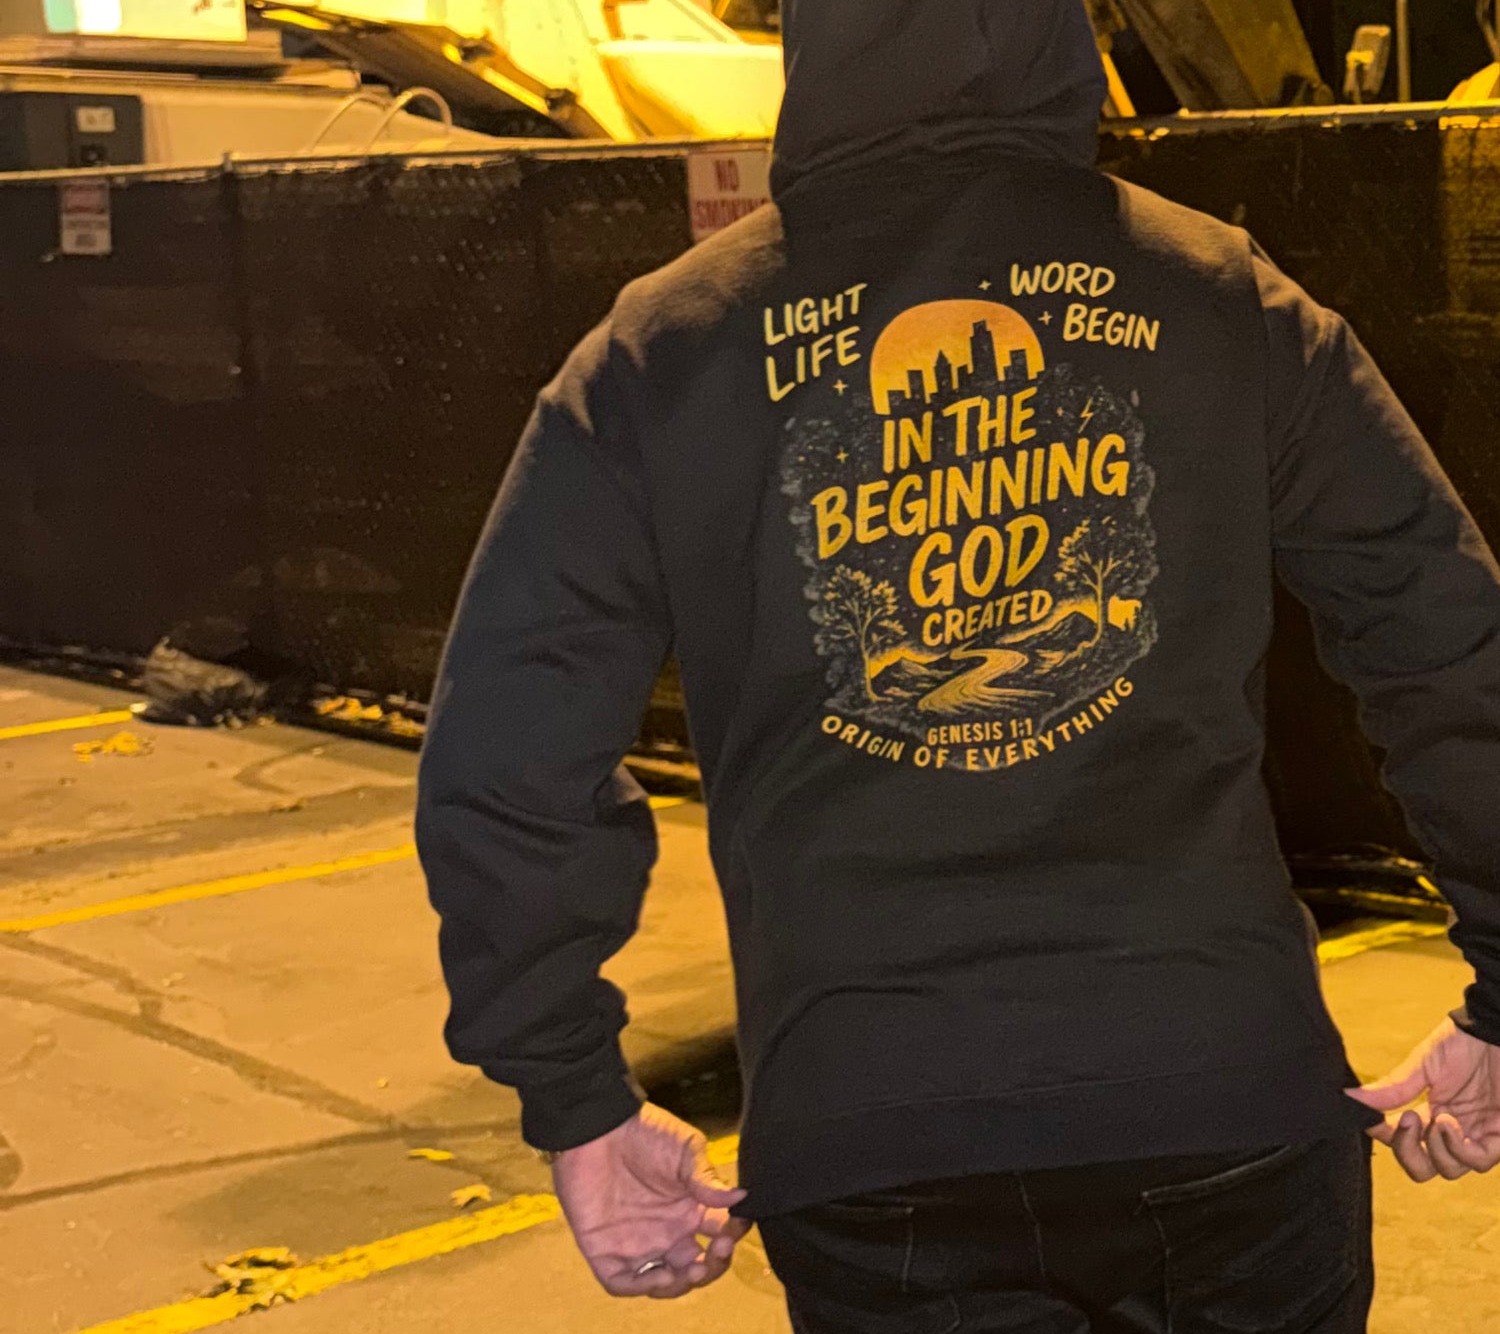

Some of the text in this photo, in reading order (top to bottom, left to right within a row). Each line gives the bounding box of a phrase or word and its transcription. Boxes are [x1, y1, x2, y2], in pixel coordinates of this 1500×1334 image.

[764, 283, 868, 345] LIGHT
[1010, 262, 1116, 297] WORD
[1063, 303, 1160, 351] BEGIN
[766, 326, 861, 402] LIFE
[883, 386, 1039, 473] IN THE
[811, 433, 1131, 559] BEGINNING
[908, 514, 1050, 609] GOD
[922, 589, 1053, 647] CREATED
[821, 676, 1135, 771] ORIGIN OF EVERYTHING
[927, 721, 1003, 747] GENESIS
